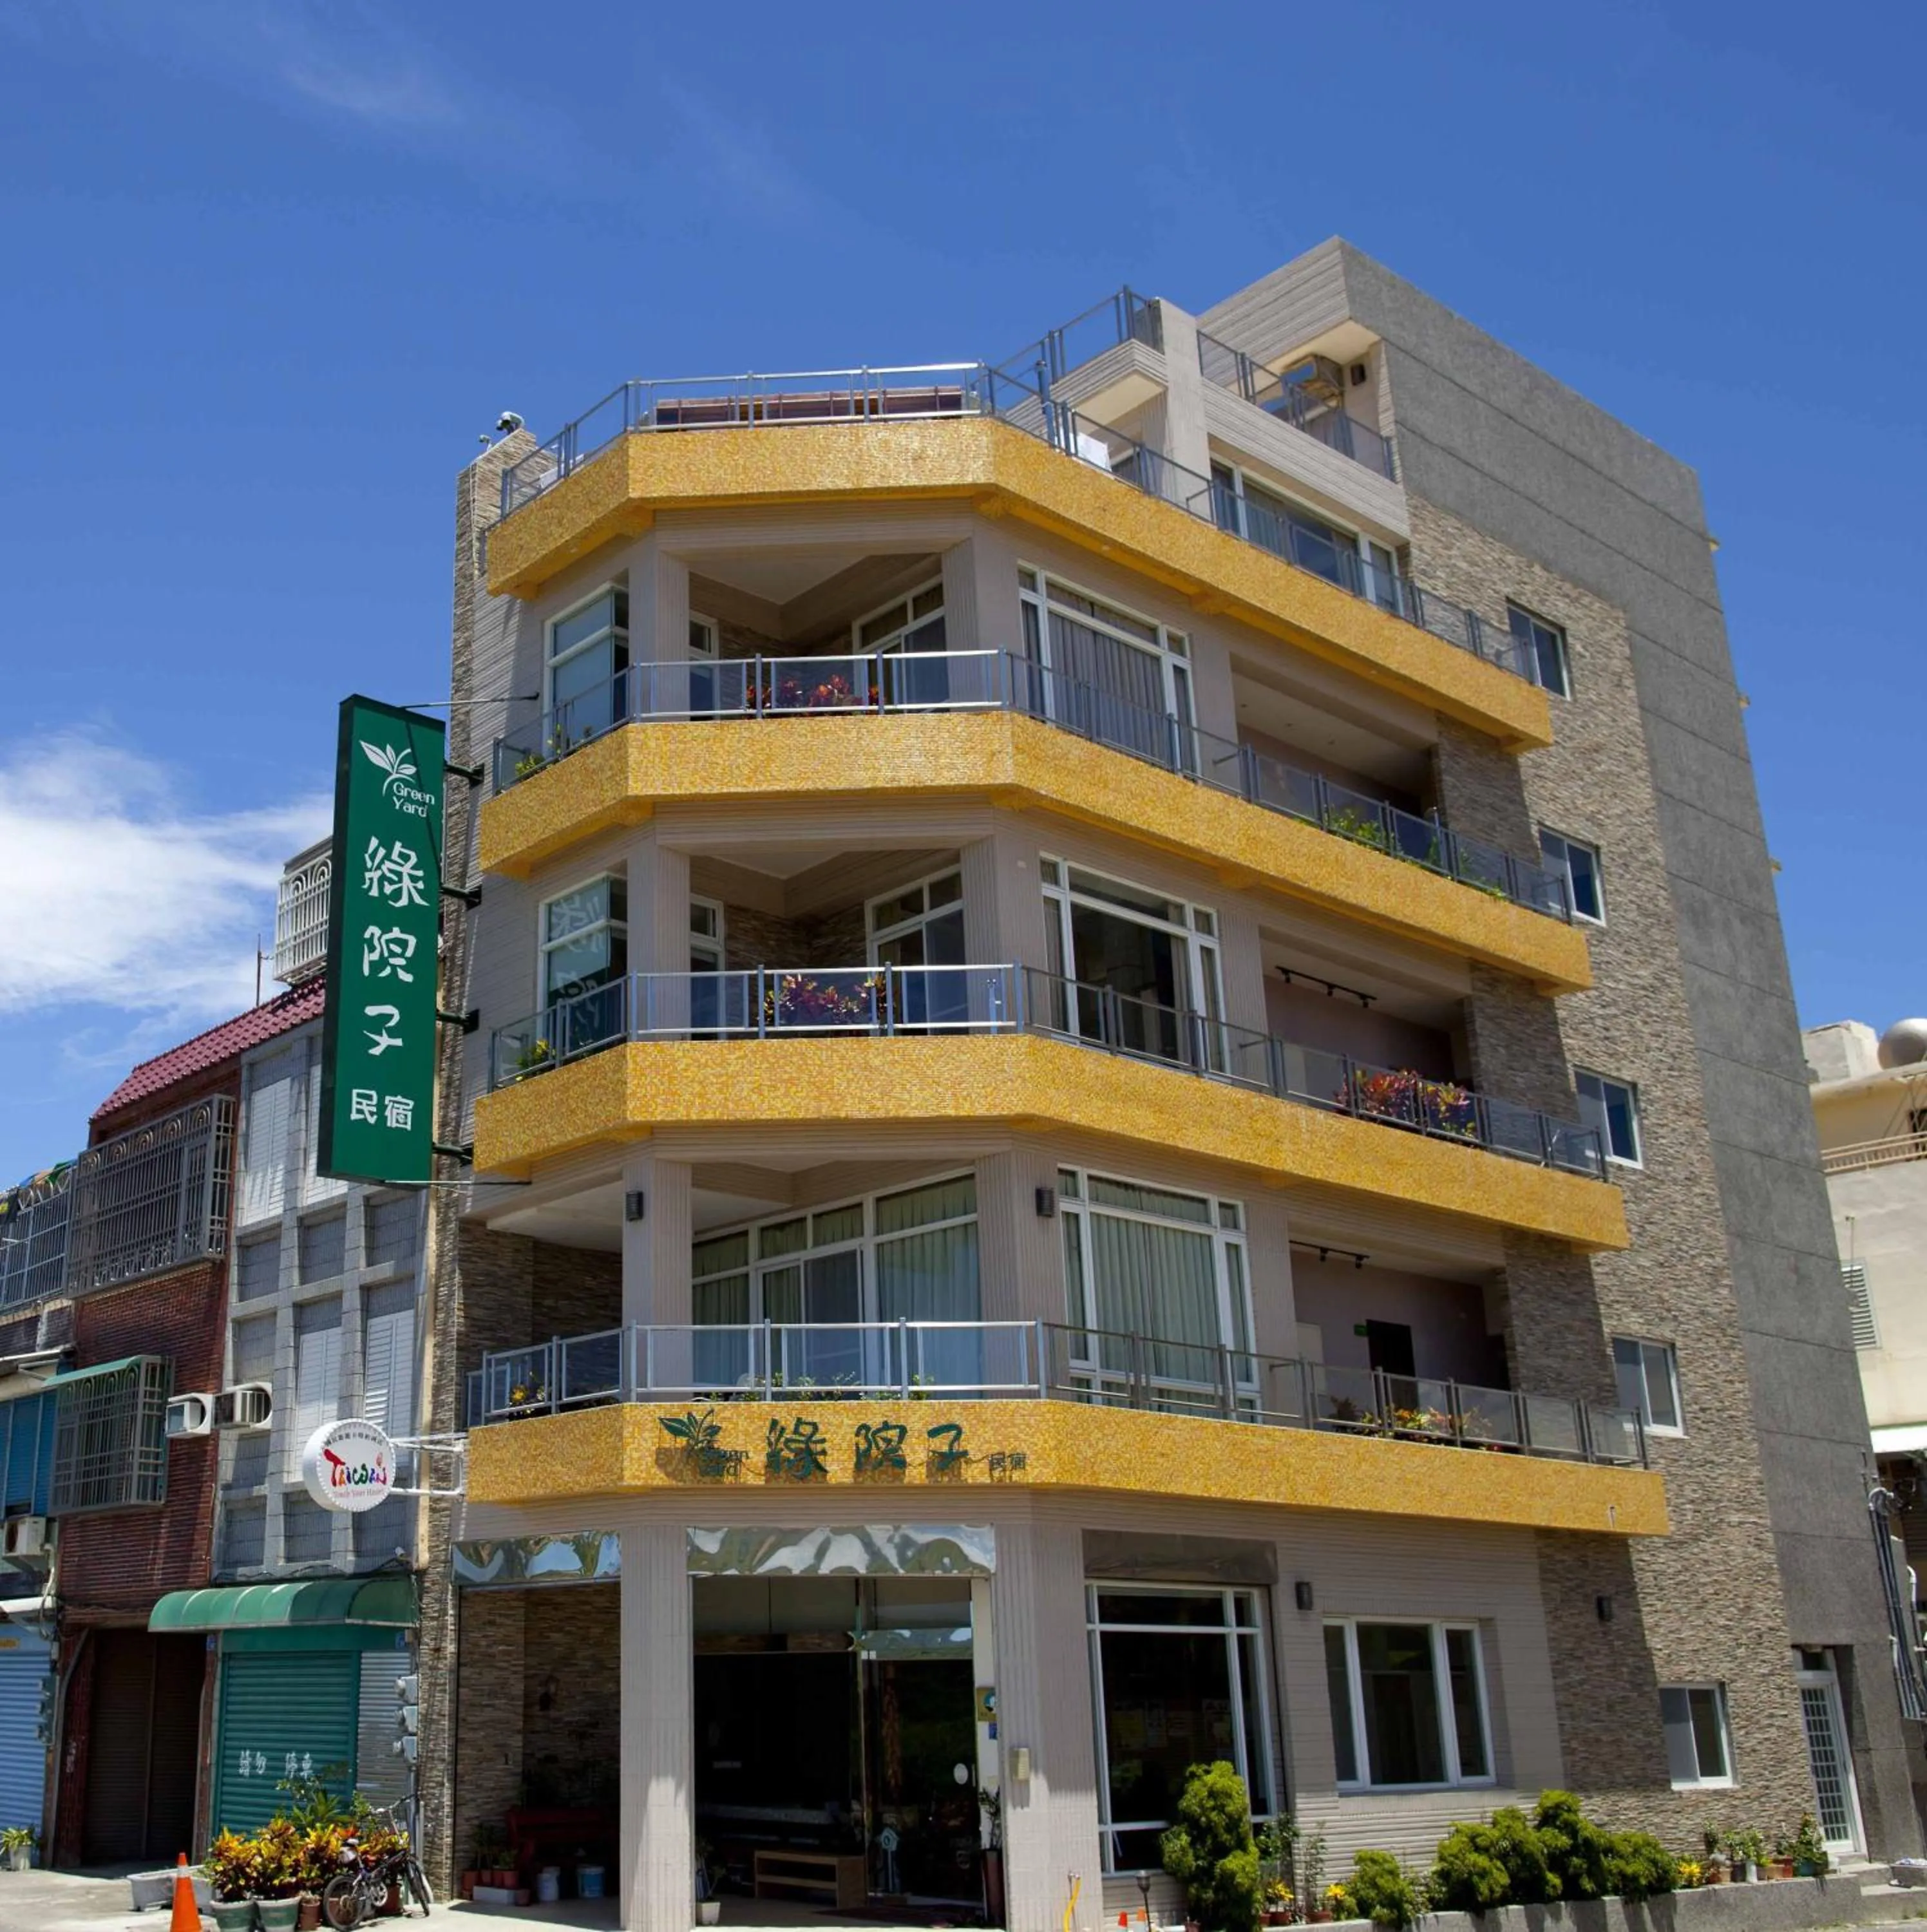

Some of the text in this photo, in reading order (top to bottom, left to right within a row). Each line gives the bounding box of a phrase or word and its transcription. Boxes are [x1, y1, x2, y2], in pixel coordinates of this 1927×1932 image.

[393, 781, 435, 805] Green
[392, 795, 428, 817] Yard
[350, 1089, 414, 1131] 民宿
